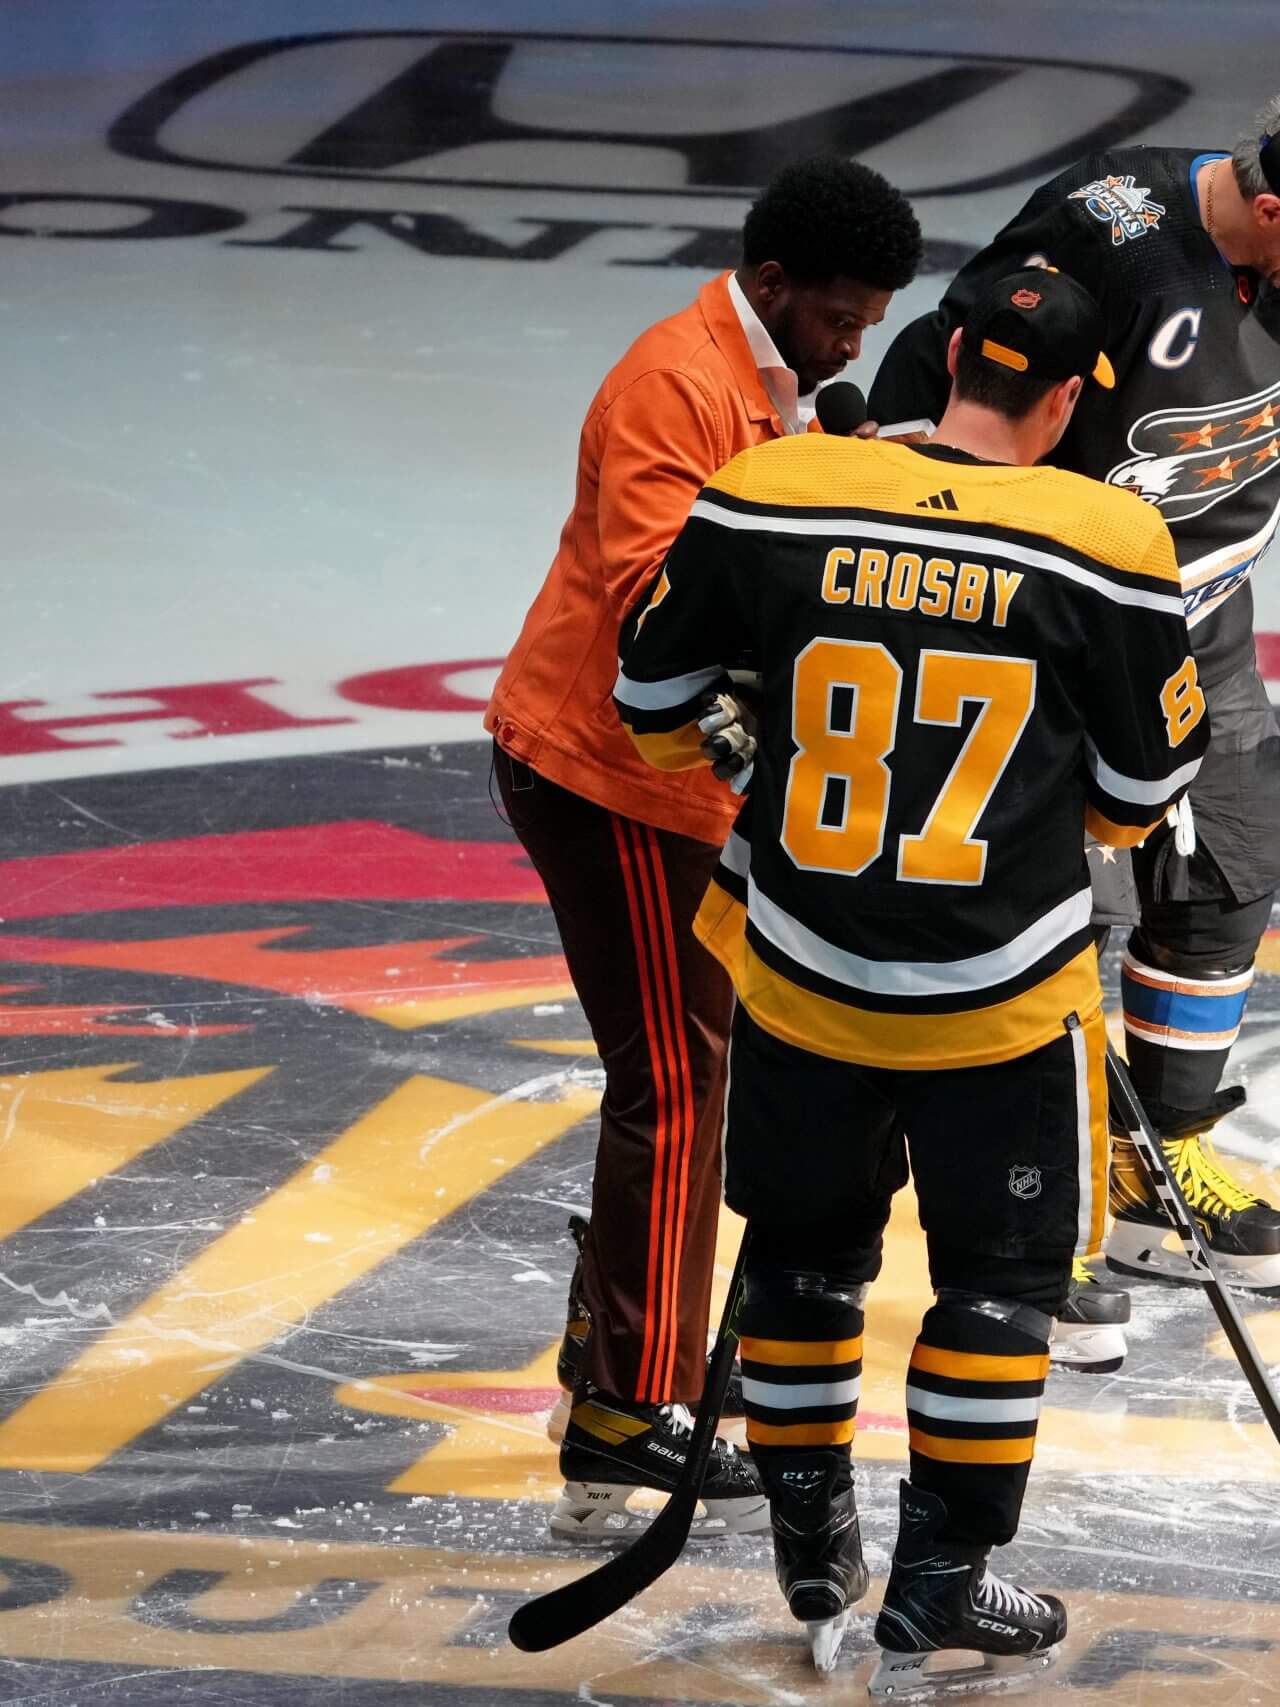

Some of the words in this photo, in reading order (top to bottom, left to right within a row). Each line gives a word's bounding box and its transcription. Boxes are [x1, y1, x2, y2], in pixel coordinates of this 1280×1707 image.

[1148, 307, 1201, 370] C
[820, 546, 1024, 628] CROSBY
[1158, 655, 1207, 749] 8
[779, 636, 1037, 887] 87
[646, 1441, 687, 1465] BAUE
[976, 1617, 1021, 1637] CCM
